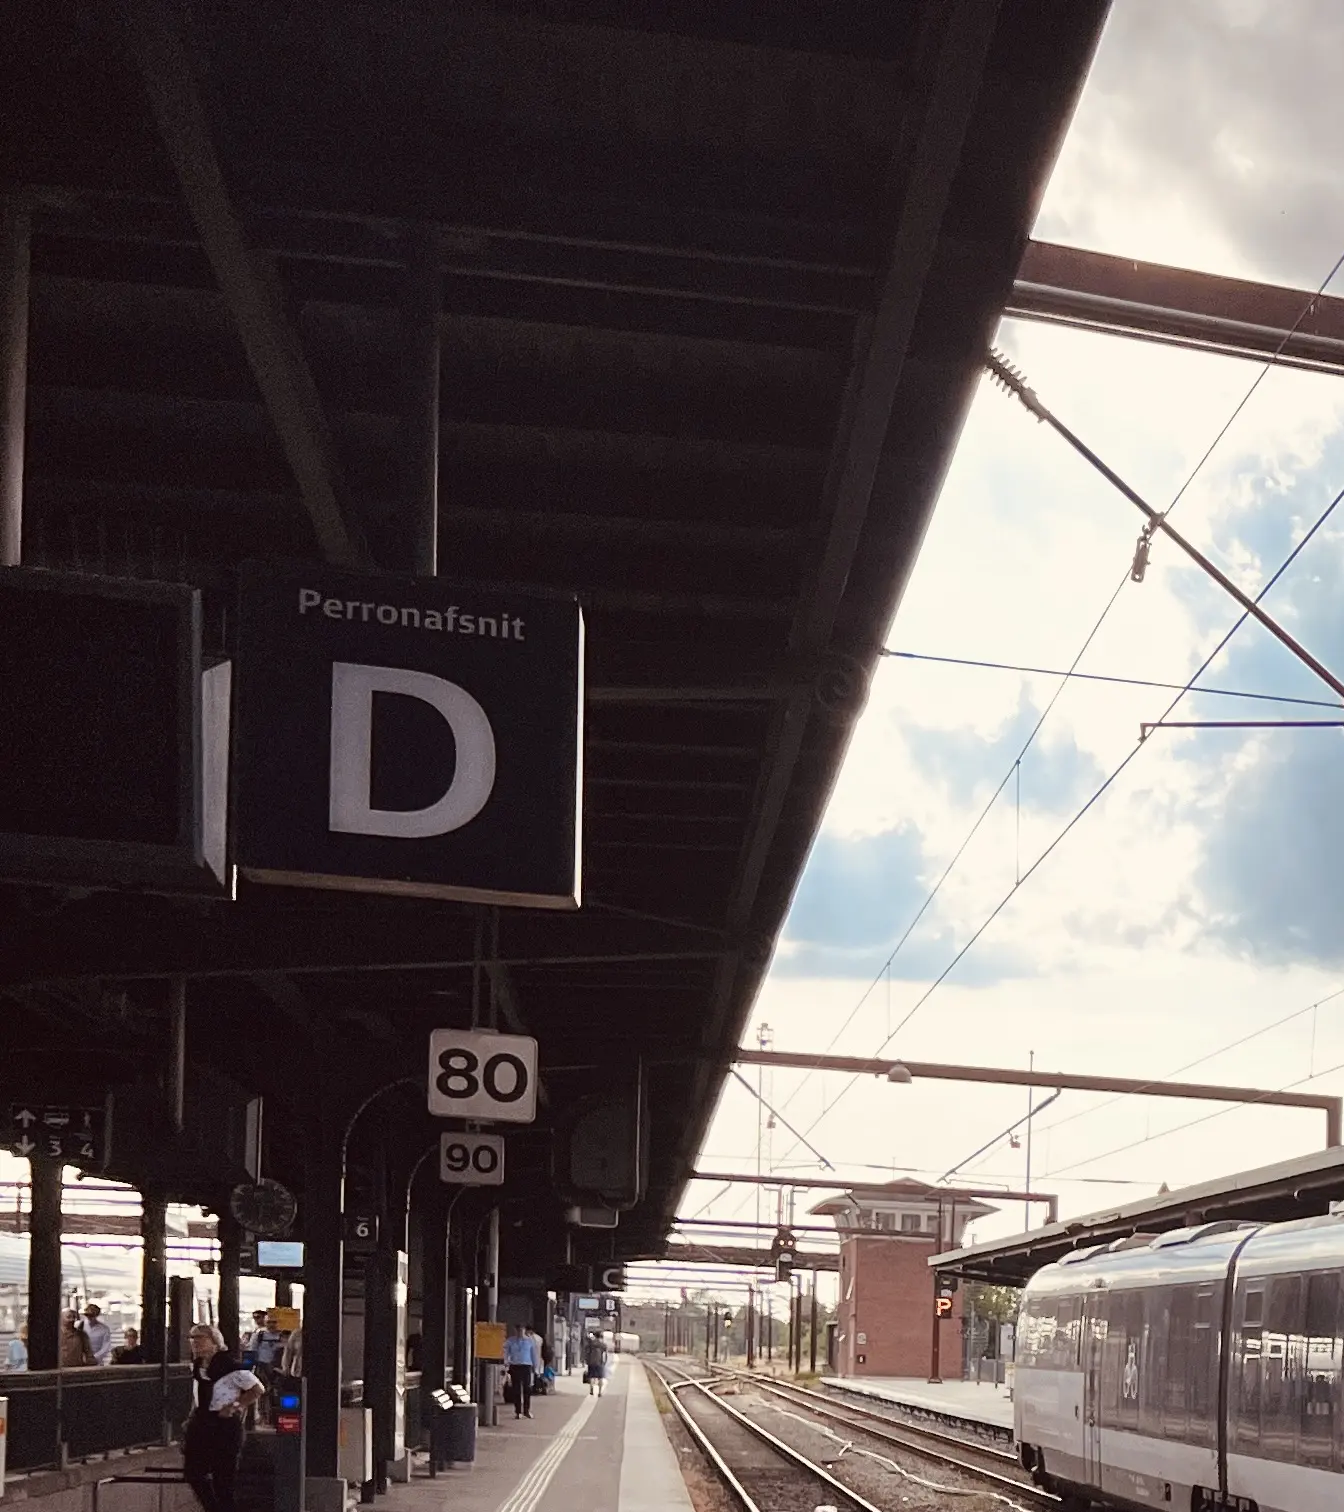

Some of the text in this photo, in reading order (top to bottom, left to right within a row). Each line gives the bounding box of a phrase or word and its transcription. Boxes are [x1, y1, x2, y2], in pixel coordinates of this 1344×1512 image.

[299, 588, 525, 641] Perronafsnit
[329, 661, 496, 838] D
[436, 1048, 528, 1103] 80
[446, 1143, 498, 1174] 90
[356, 1222, 369, 1237] 6
[603, 1269, 620, 1288] C
[936, 1298, 952, 1316] P
